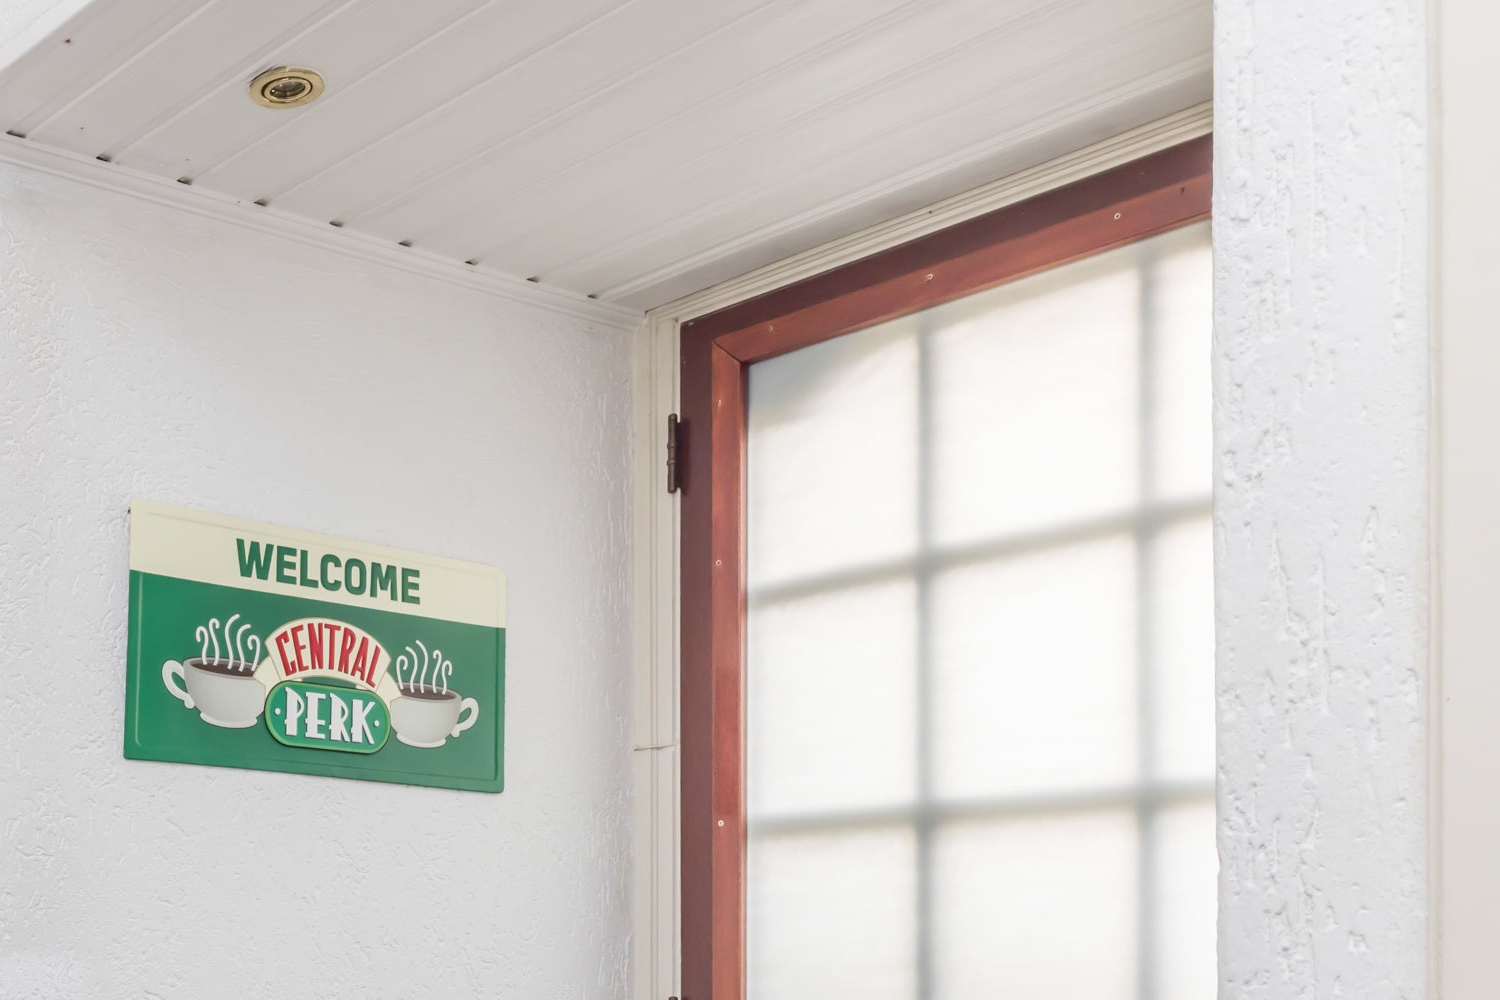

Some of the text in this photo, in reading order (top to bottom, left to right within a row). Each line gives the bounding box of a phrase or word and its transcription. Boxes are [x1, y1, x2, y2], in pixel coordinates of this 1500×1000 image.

[236, 538, 420, 605] WELCOME
[275, 622, 381, 687] CENTRAL
[284, 687, 375, 744] PERK
